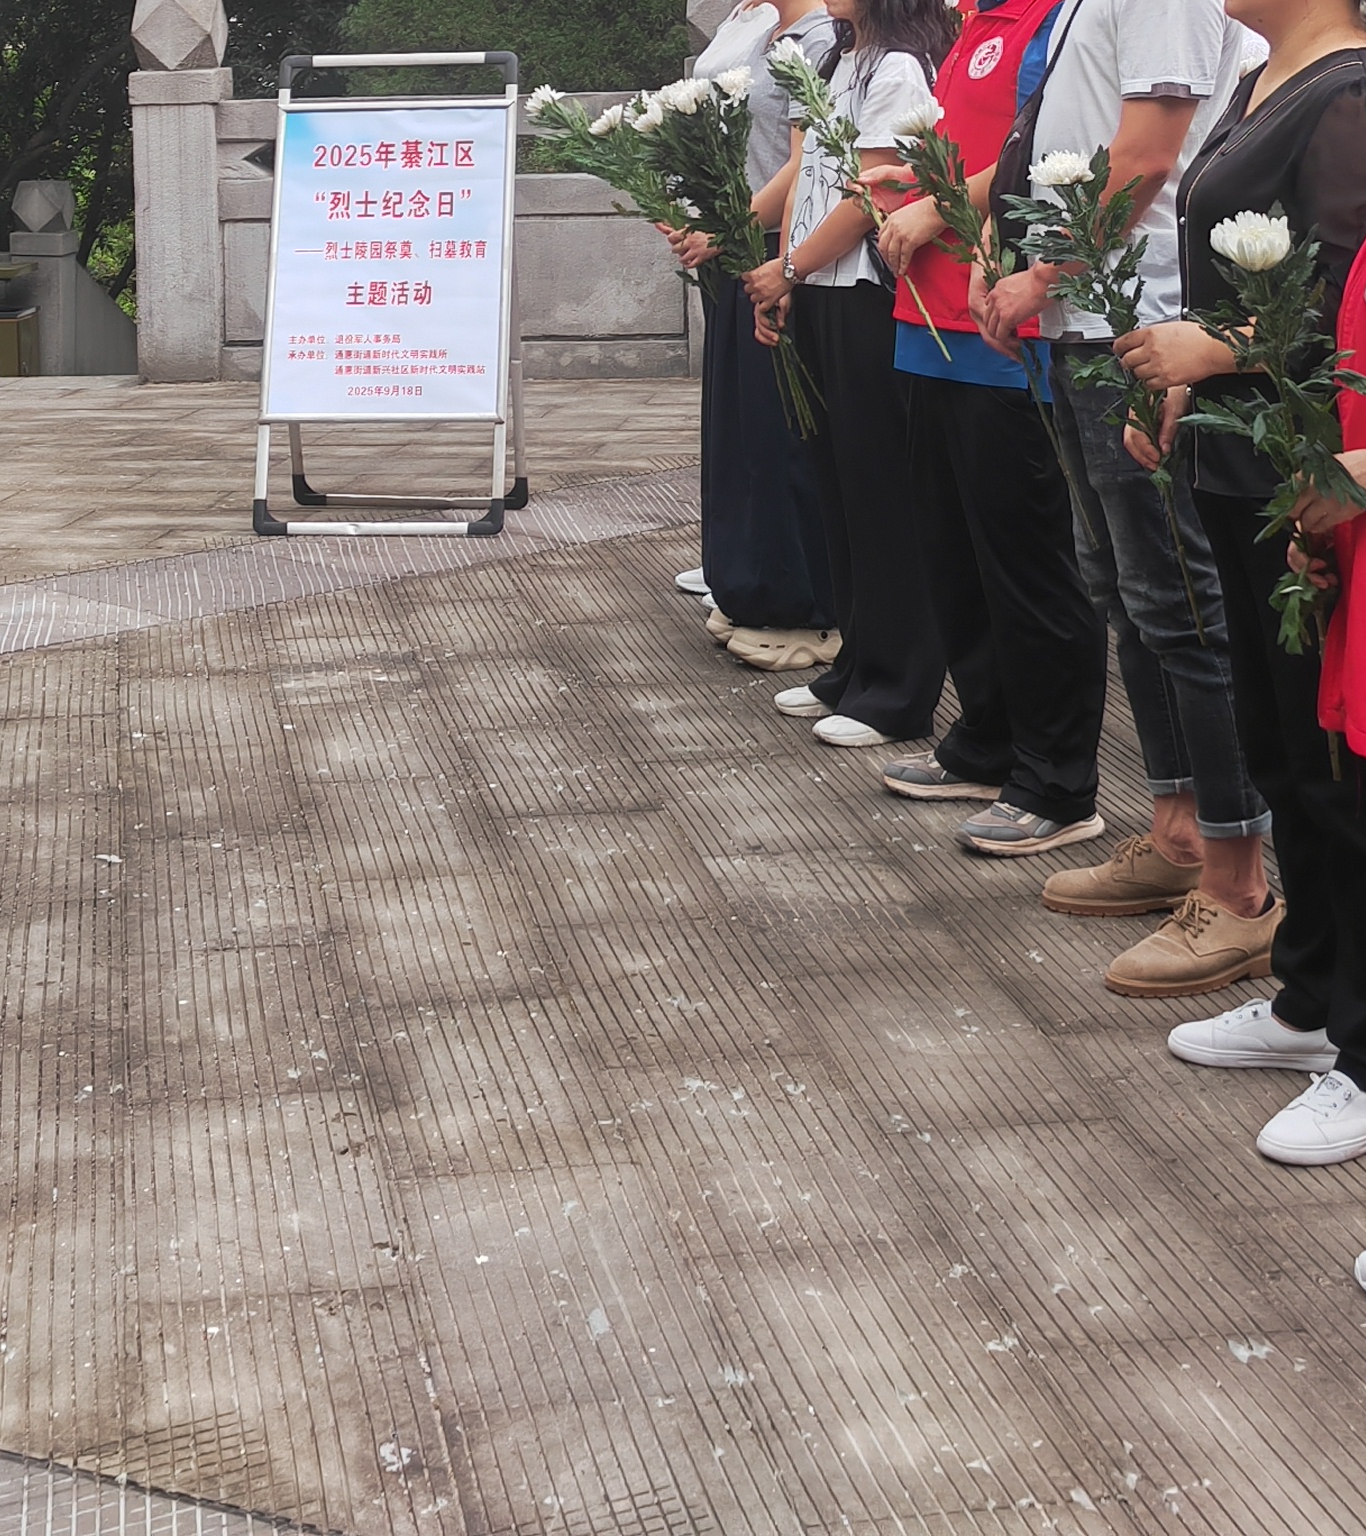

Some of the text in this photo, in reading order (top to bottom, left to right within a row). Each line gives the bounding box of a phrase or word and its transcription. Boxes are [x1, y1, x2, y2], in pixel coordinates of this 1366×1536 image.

[314, 140, 475, 169] 2025年綦江区
[315, 189, 472, 219] “烈士纪念日”
[346, 280, 432, 306] 主题活动
[347, 385, 423, 397] 2025年9月18日
